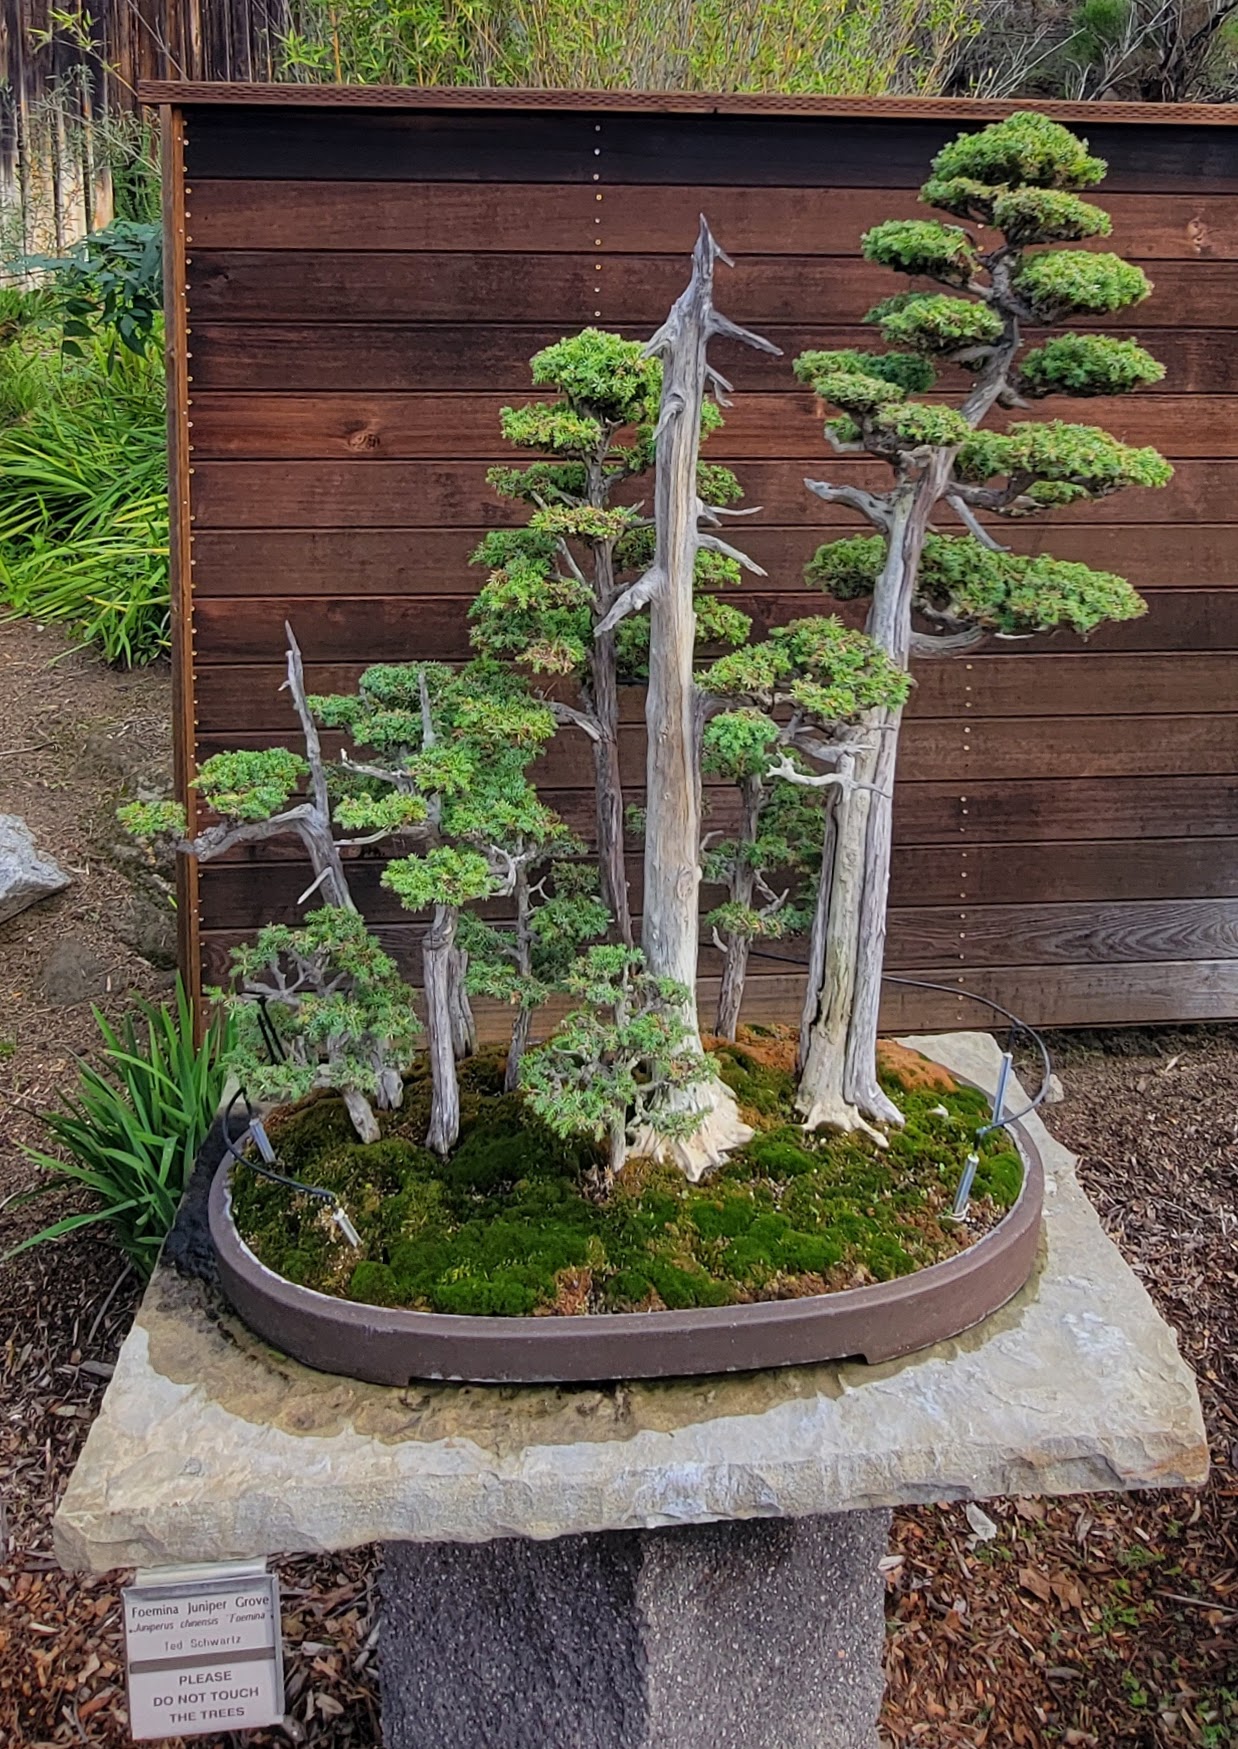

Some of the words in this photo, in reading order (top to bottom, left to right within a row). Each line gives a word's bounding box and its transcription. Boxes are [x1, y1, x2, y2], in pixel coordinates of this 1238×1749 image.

[132, 1604, 179, 1618] Foemina
[188, 1600, 227, 1615] Juniper
[235, 1596, 270, 1608] Grove
[165, 1640, 183, 1651] Ted
[190, 1635, 241, 1648] Schwartz
[179, 1670, 232, 1686] PLEASE
[153, 1695, 174, 1707] DO
[178, 1692, 206, 1704] NOT
[210, 1686, 259, 1701] TOUCH
[169, 1711, 197, 1723] THE
[200, 1706, 245, 1720] TREES
